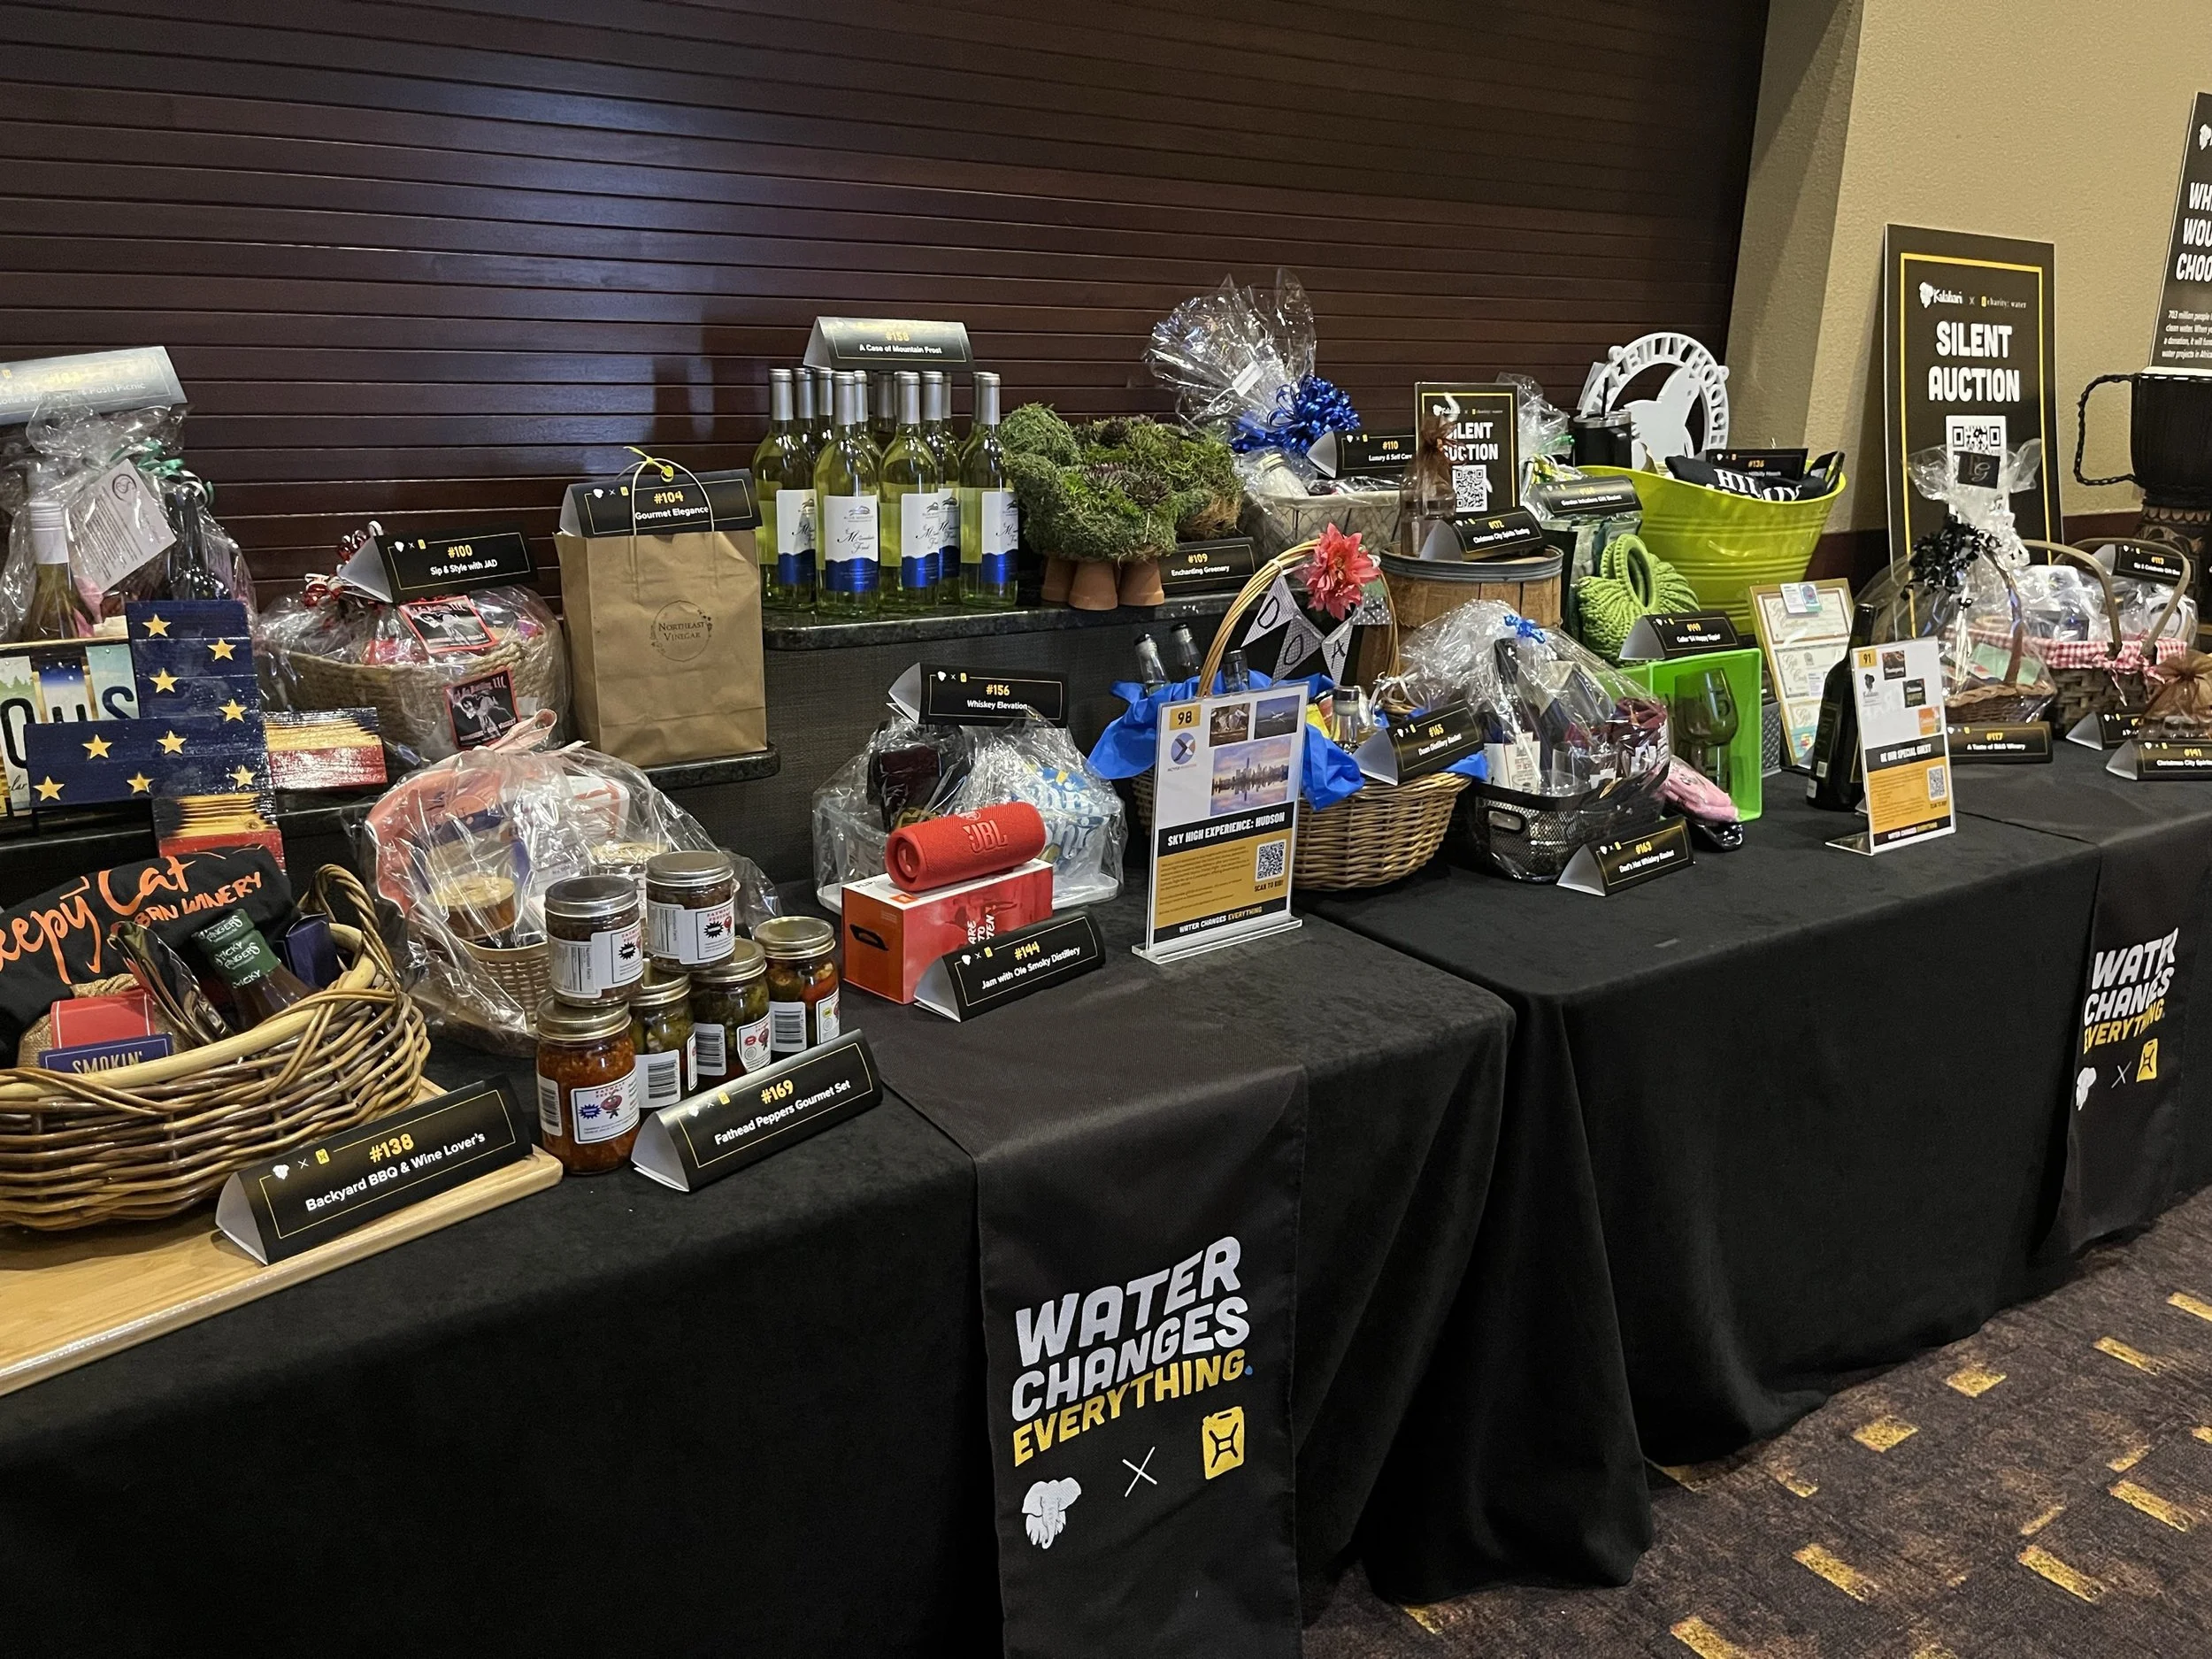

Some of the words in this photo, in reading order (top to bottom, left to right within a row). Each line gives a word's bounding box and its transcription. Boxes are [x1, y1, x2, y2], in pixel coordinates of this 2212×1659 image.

[892, 345, 924, 354] Mountain
[1935, 320, 2013, 358] SILENT
[1928, 365, 2020, 403] AUCTION
[1382, 441, 1399, 450] #110
[1443, 443, 1499, 461] UCTION
[653, 490, 684, 505] #104
[635, 508, 672, 521] Gourmet
[672, 505, 710, 518] Elegance
[447, 545, 473, 558] #100
[1187, 553, 1208, 564] #109
[430, 566, 443, 576] Sip
[443, 565, 449, 574] &
[449, 564, 468, 574] Style
[467, 561, 483, 571] with
[1171, 566, 1203, 577] Enchanting
[1203, 565, 1230, 574] Greenery
[658, 621, 705, 632] NORTHEAST
[664, 632, 702, 642] VINEGAR
[1863, 653, 1871, 664] 91
[986, 684, 1010, 696] #156
[966, 699, 996, 710] Whiskey
[996, 701, 1028, 710] Elevation
[1177, 710, 1193, 726] 98
[967, 819, 1009, 854] JBL
[1167, 833, 1185, 847] SKY
[1185, 829, 1204, 842] HIGH
[1204, 820, 1255, 839] EXPERIENCE:
[1255, 811, 1286, 828] HUDSON
[1635, 841, 1653, 855] #163
[98, 856, 197, 917] Cat
[181, 872, 262, 916] WINERY
[1254, 883, 1267, 892] SCAN
[1200, 915, 1227, 928] CHANGES
[1227, 906, 1263, 921] EVERYTHING
[967, 919, 976, 945] ARE
[224, 941, 262, 971] FINGERS
[1014, 941, 1041, 961] #144
[2091, 927, 2179, 991] WATR
[981, 978, 997, 990] Jam
[997, 971, 1014, 983] with
[1013, 965, 1027, 977] Ole
[1027, 957, 1051, 972] Smoky
[1050, 947, 1080, 964] Distillery
[72, 1050, 144, 1074] SMOKIN'
[760, 1079, 795, 1104] #169
[714, 1119, 756, 1146] Fathead
[756, 1105, 795, 1128] Peppers
[795, 1087, 836, 1110] Gourmet
[835, 1079, 851, 1094] Set
[369, 1133, 415, 1164] #138
[304, 1179, 368, 1212] Backyard
[368, 1165, 400, 1187] BBQ
[399, 1162, 411, 1174] &
[411, 1147, 442, 1170] Wine
[442, 1132, 487, 1157] Lover's
[1015, 1236, 1241, 1367] WATER
[1012, 1296, 1250, 1422] CHANGES
[1013, 1348, 1245, 1468] EVERYTHING
